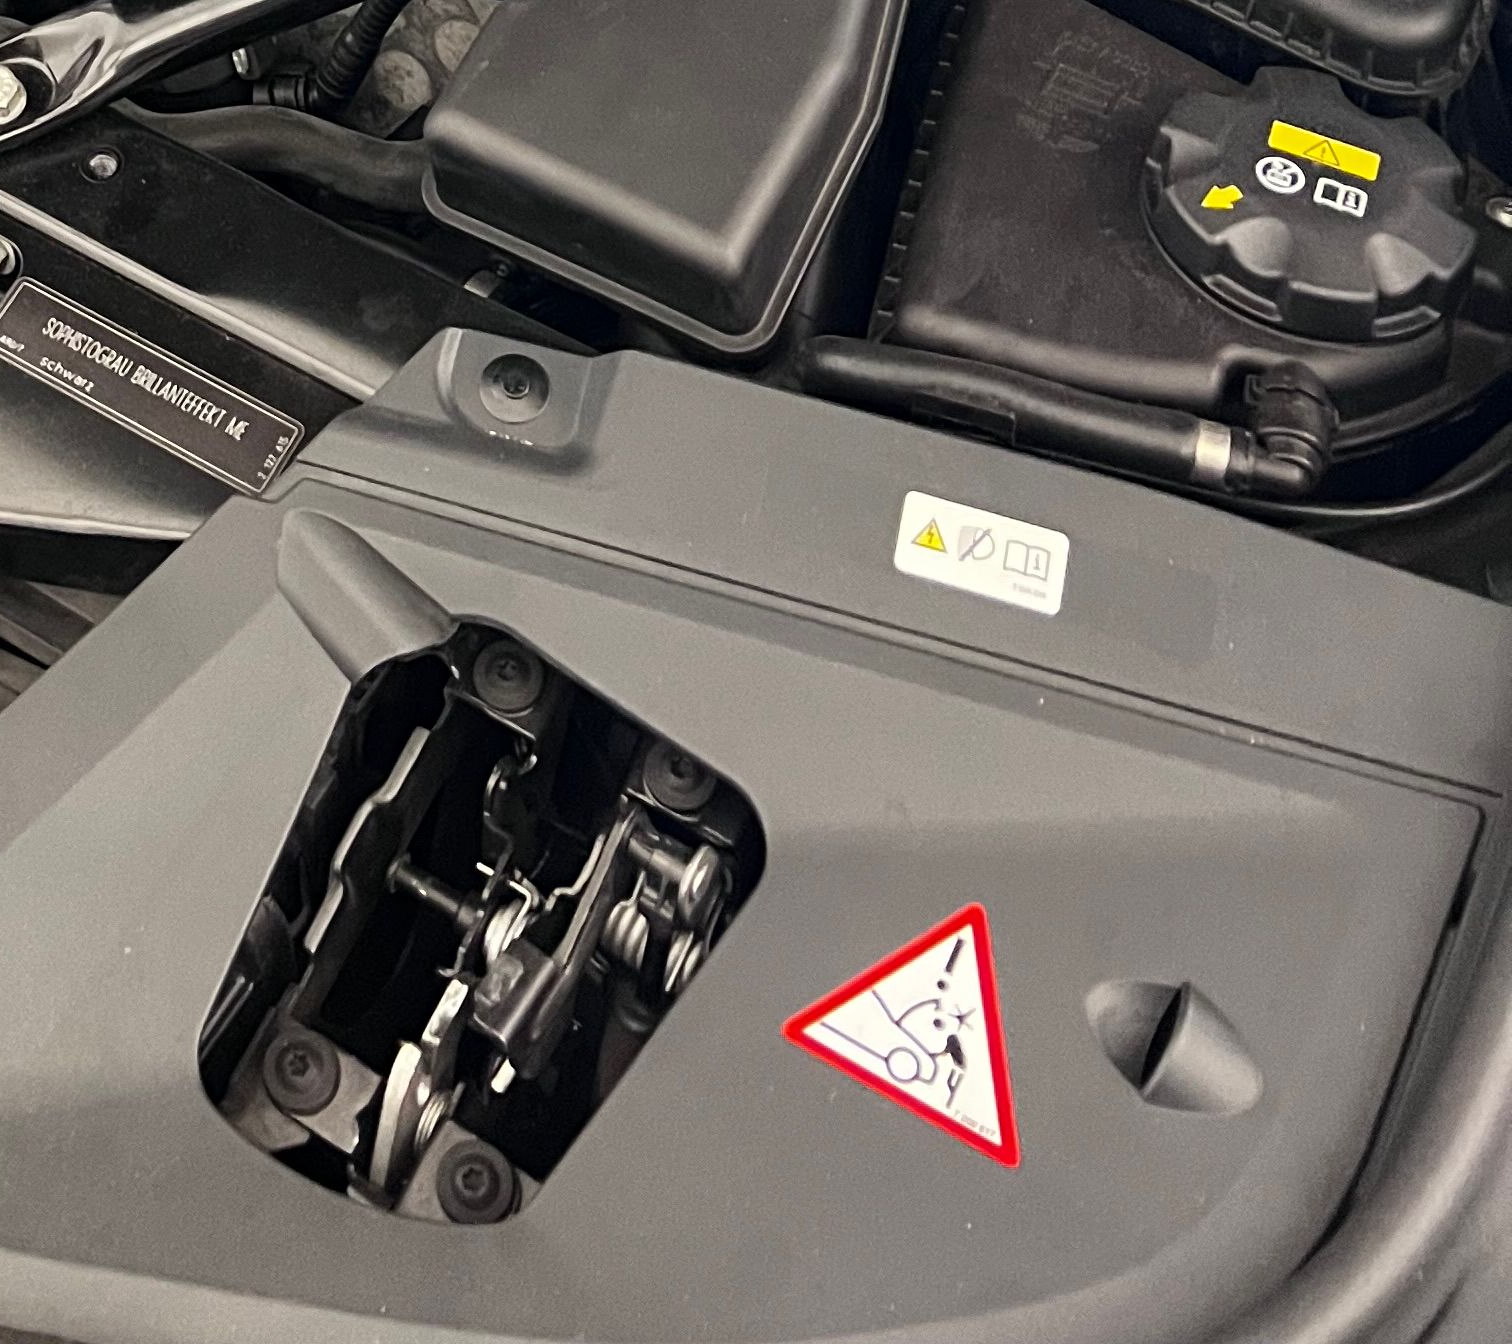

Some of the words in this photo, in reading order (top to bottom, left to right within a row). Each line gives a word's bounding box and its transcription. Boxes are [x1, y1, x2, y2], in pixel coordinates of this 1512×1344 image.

[39, 356, 95, 393] schwarz
[41, 317, 133, 377] SOPHISTOGRAU
[130, 364, 227, 428] BRILLANTEFFEKT
